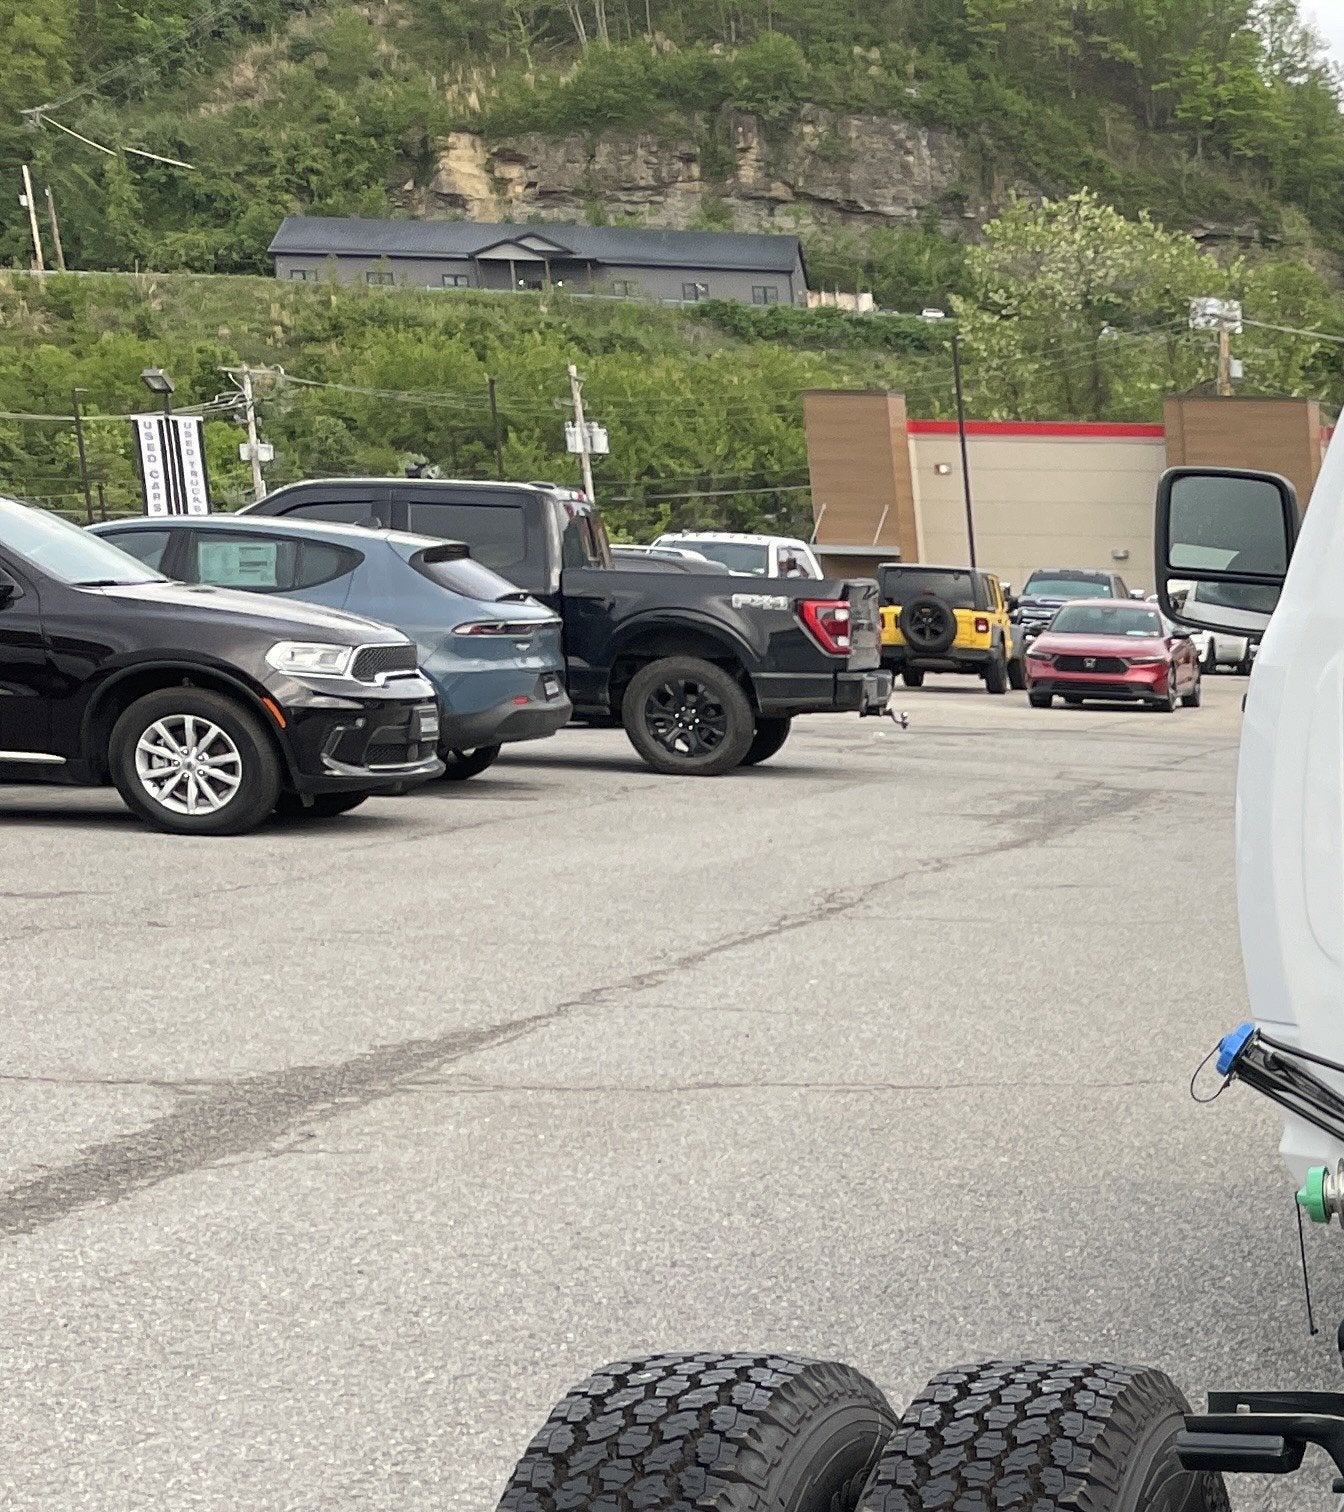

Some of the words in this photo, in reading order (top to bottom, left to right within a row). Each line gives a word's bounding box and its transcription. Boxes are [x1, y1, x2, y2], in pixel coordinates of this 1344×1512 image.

[143, 421, 157, 463] USED
[183, 422, 195, 456] USED
[189, 461, 202, 513] TRUCKS
[149, 470, 162, 513] CARS
